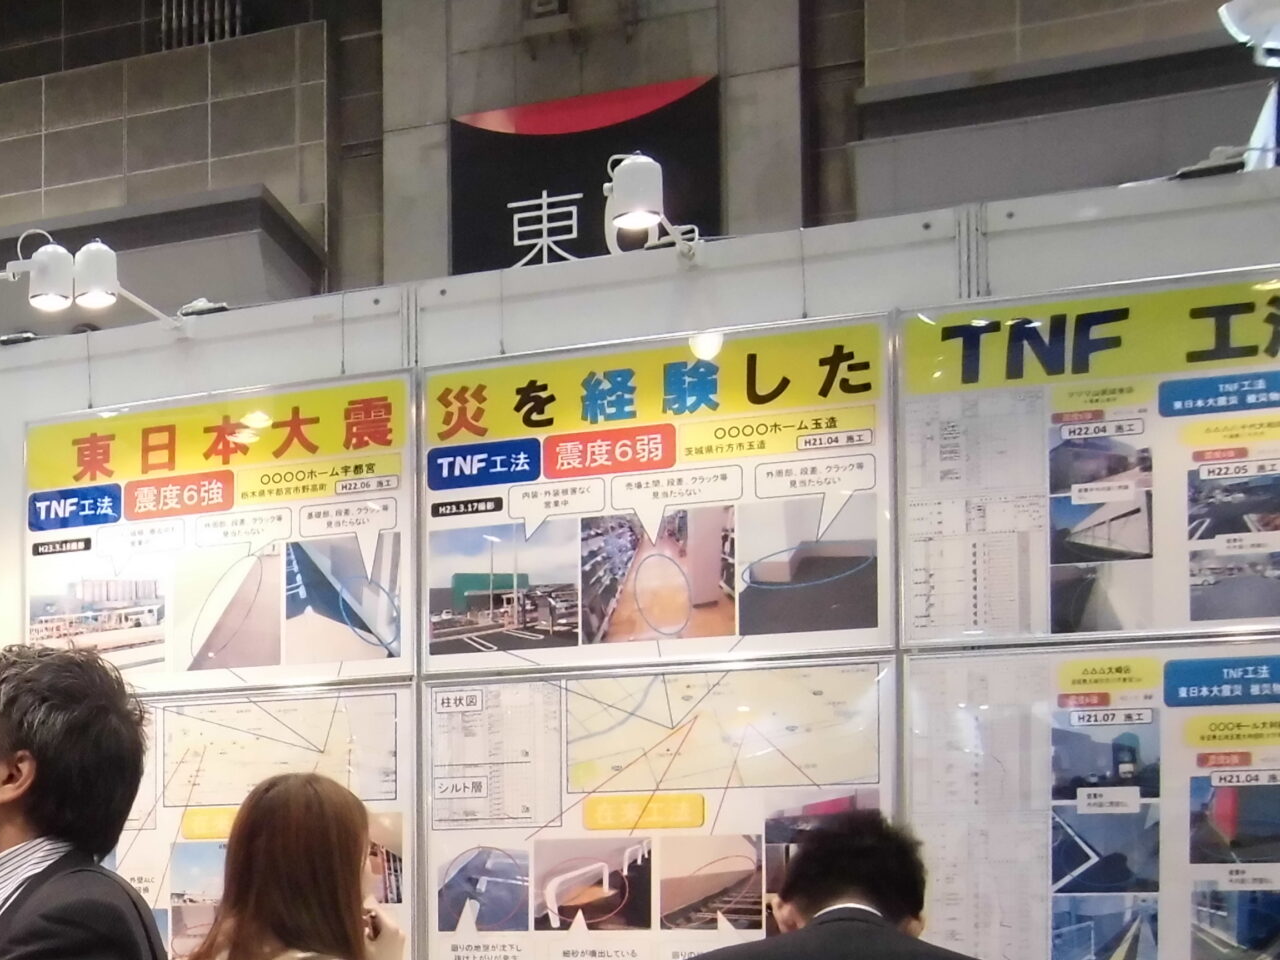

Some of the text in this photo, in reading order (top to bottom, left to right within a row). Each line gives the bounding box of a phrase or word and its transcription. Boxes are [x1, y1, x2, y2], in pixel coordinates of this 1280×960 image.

[507, 189, 584, 268] 東
[940, 306, 1131, 385] TNF
[71, 395, 394, 483] 東日本大震
[554, 433, 665, 472] 震度6弱
[803, 436, 840, 449] H21.04
[436, 451, 531, 479] TNF工法
[35, 495, 114, 521] TNF工法
[133, 479, 224, 514] 震度6強
[440, 695, 478, 708] 柱状図
[1077, 712, 1116, 724] H21.07
[438, 781, 483, 795] シルト層
[1218, 773, 1260, 785] H21.04
